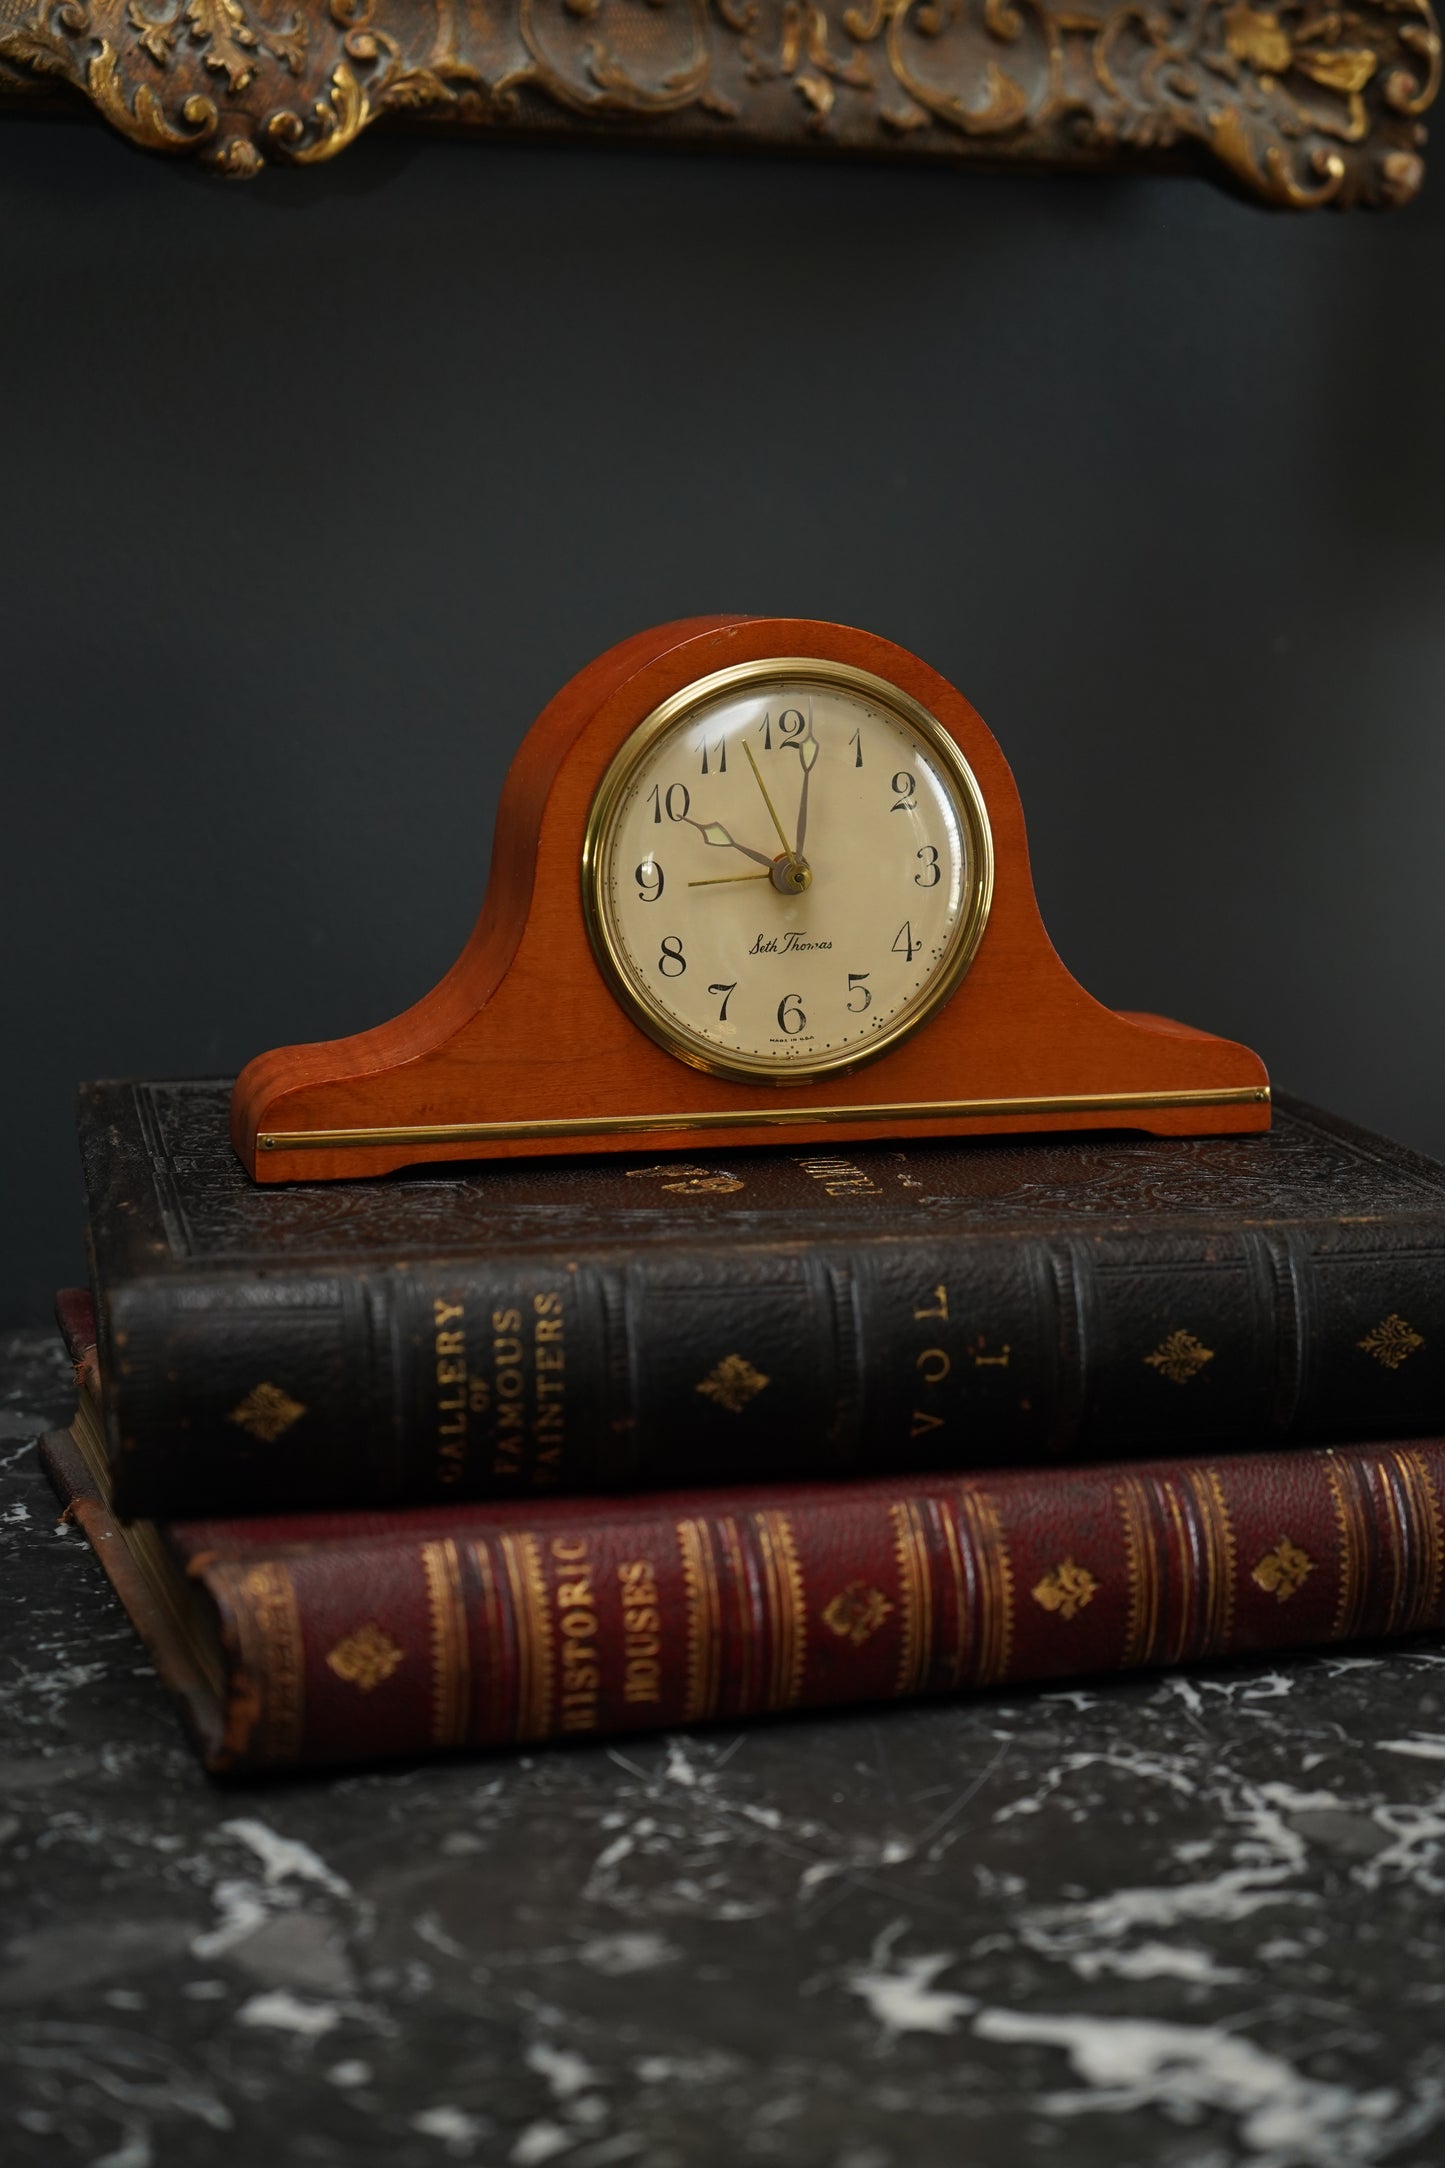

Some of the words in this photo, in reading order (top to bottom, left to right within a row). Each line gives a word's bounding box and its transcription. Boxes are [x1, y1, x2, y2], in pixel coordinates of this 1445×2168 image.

[758, 709, 806, 750] 12
[848, 727, 863, 768] 1
[694, 733, 727, 775] 11
[646, 782, 691, 824] 10
[890, 771, 918, 812] 2
[634, 861, 665, 902] 9
[914, 845, 942, 888] 3
[658, 935, 687, 978] 8
[748, 933, 778, 955] Seth
[777, 931, 833, 955] Thomas
[891, 920, 923, 962] 4
[707, 982, 738, 1021] 7
[846, 972, 873, 1013] 5
[777, 993, 807, 1035] 6
[910, 1284, 949, 1439] VOL
[433, 1298, 468, 1484] GALLERY
[492, 1308, 525, 1475] FAMOUS
[551, 1537, 599, 1730] HISTORIC
[617, 1558, 662, 1703] HOUSES
